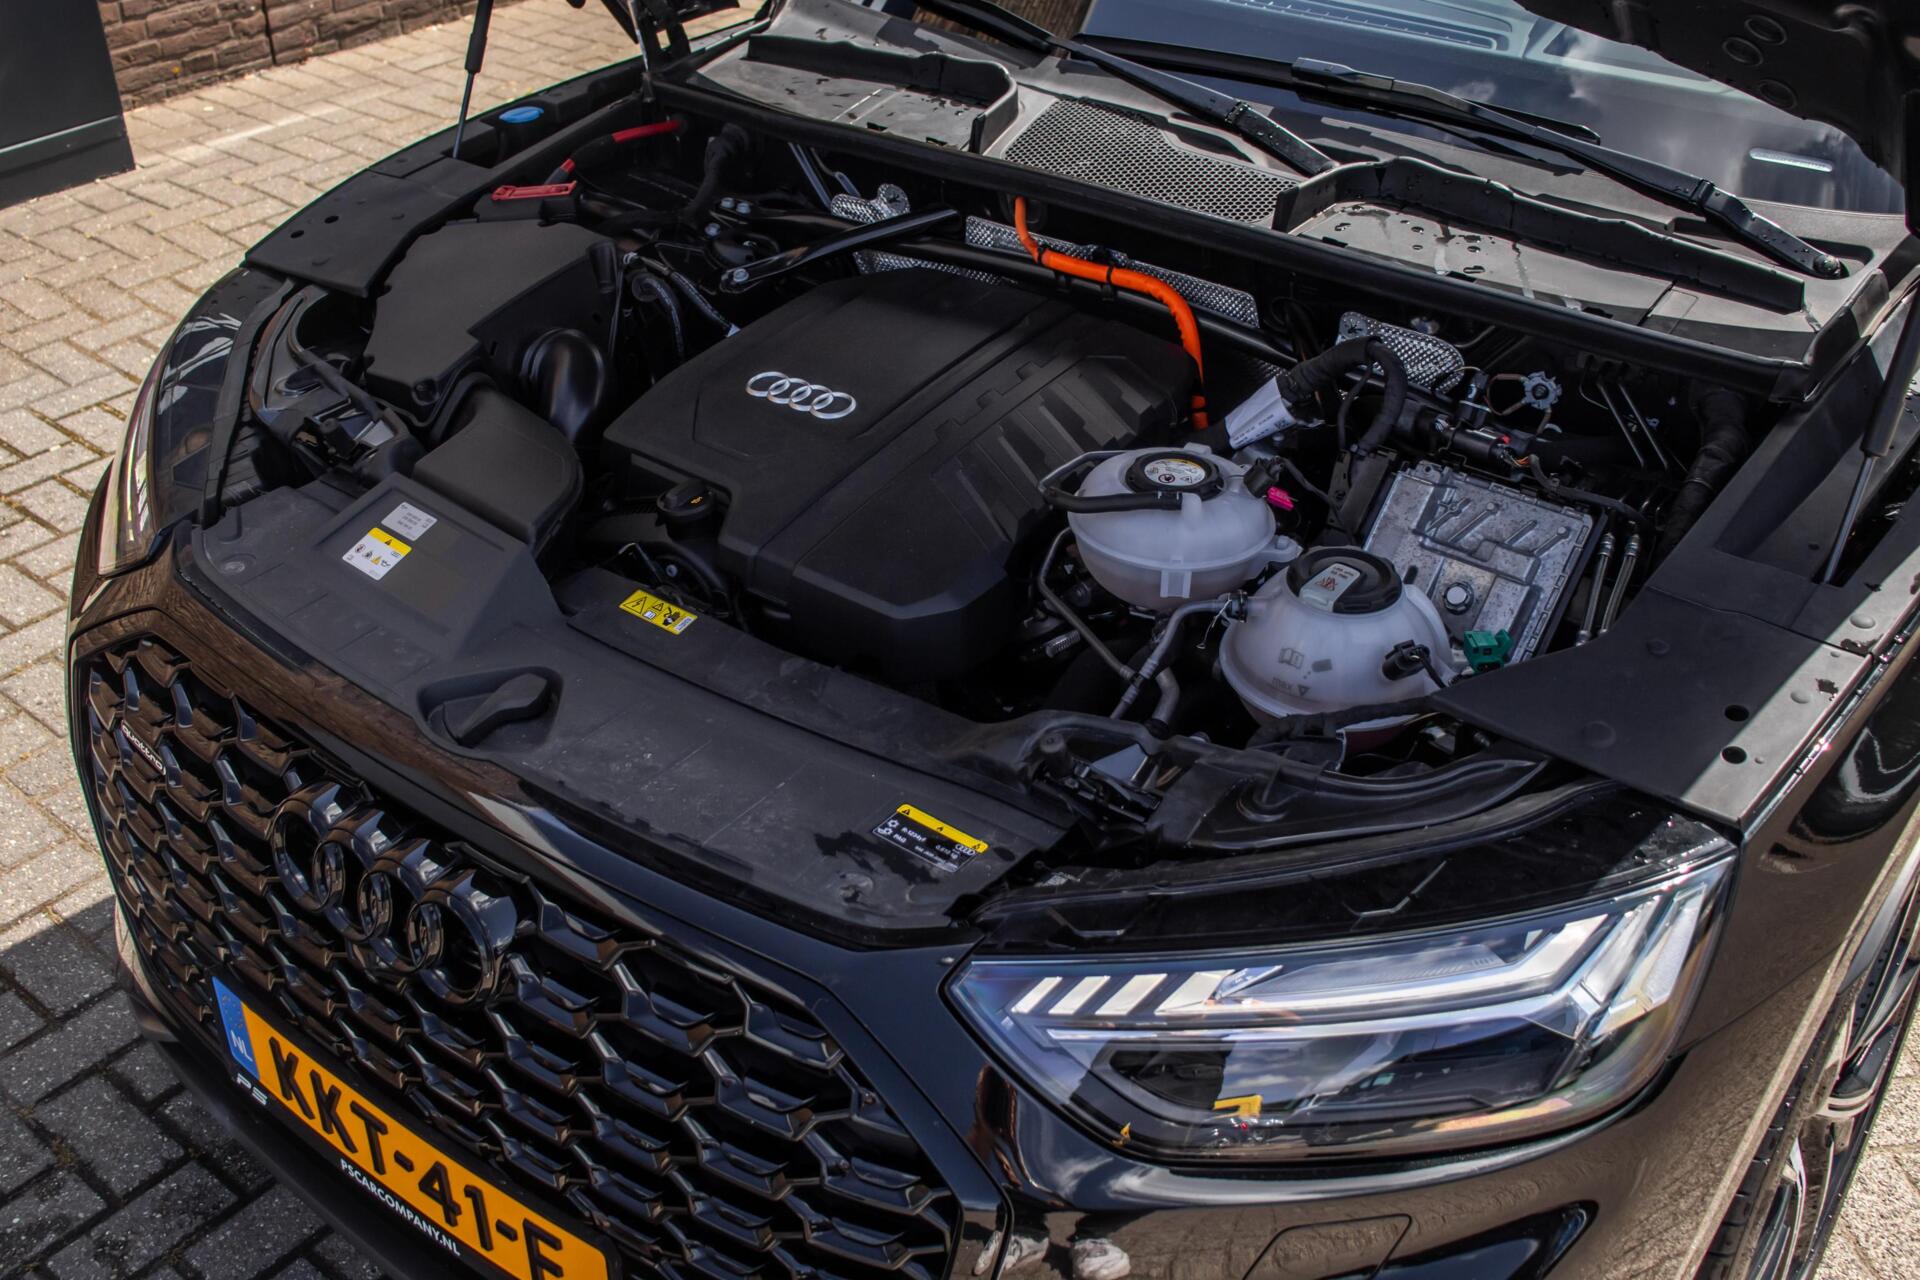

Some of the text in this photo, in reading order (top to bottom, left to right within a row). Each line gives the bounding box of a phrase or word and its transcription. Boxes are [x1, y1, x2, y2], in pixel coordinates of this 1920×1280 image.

[121, 724, 163, 770] quattro
[230, 1028, 254, 1062] NL
[236, 1072, 268, 1106] PS
[269, 1036, 565, 1280] KKT-41-F
[340, 1158, 461, 1257] PSCARCOMPANY.NL
